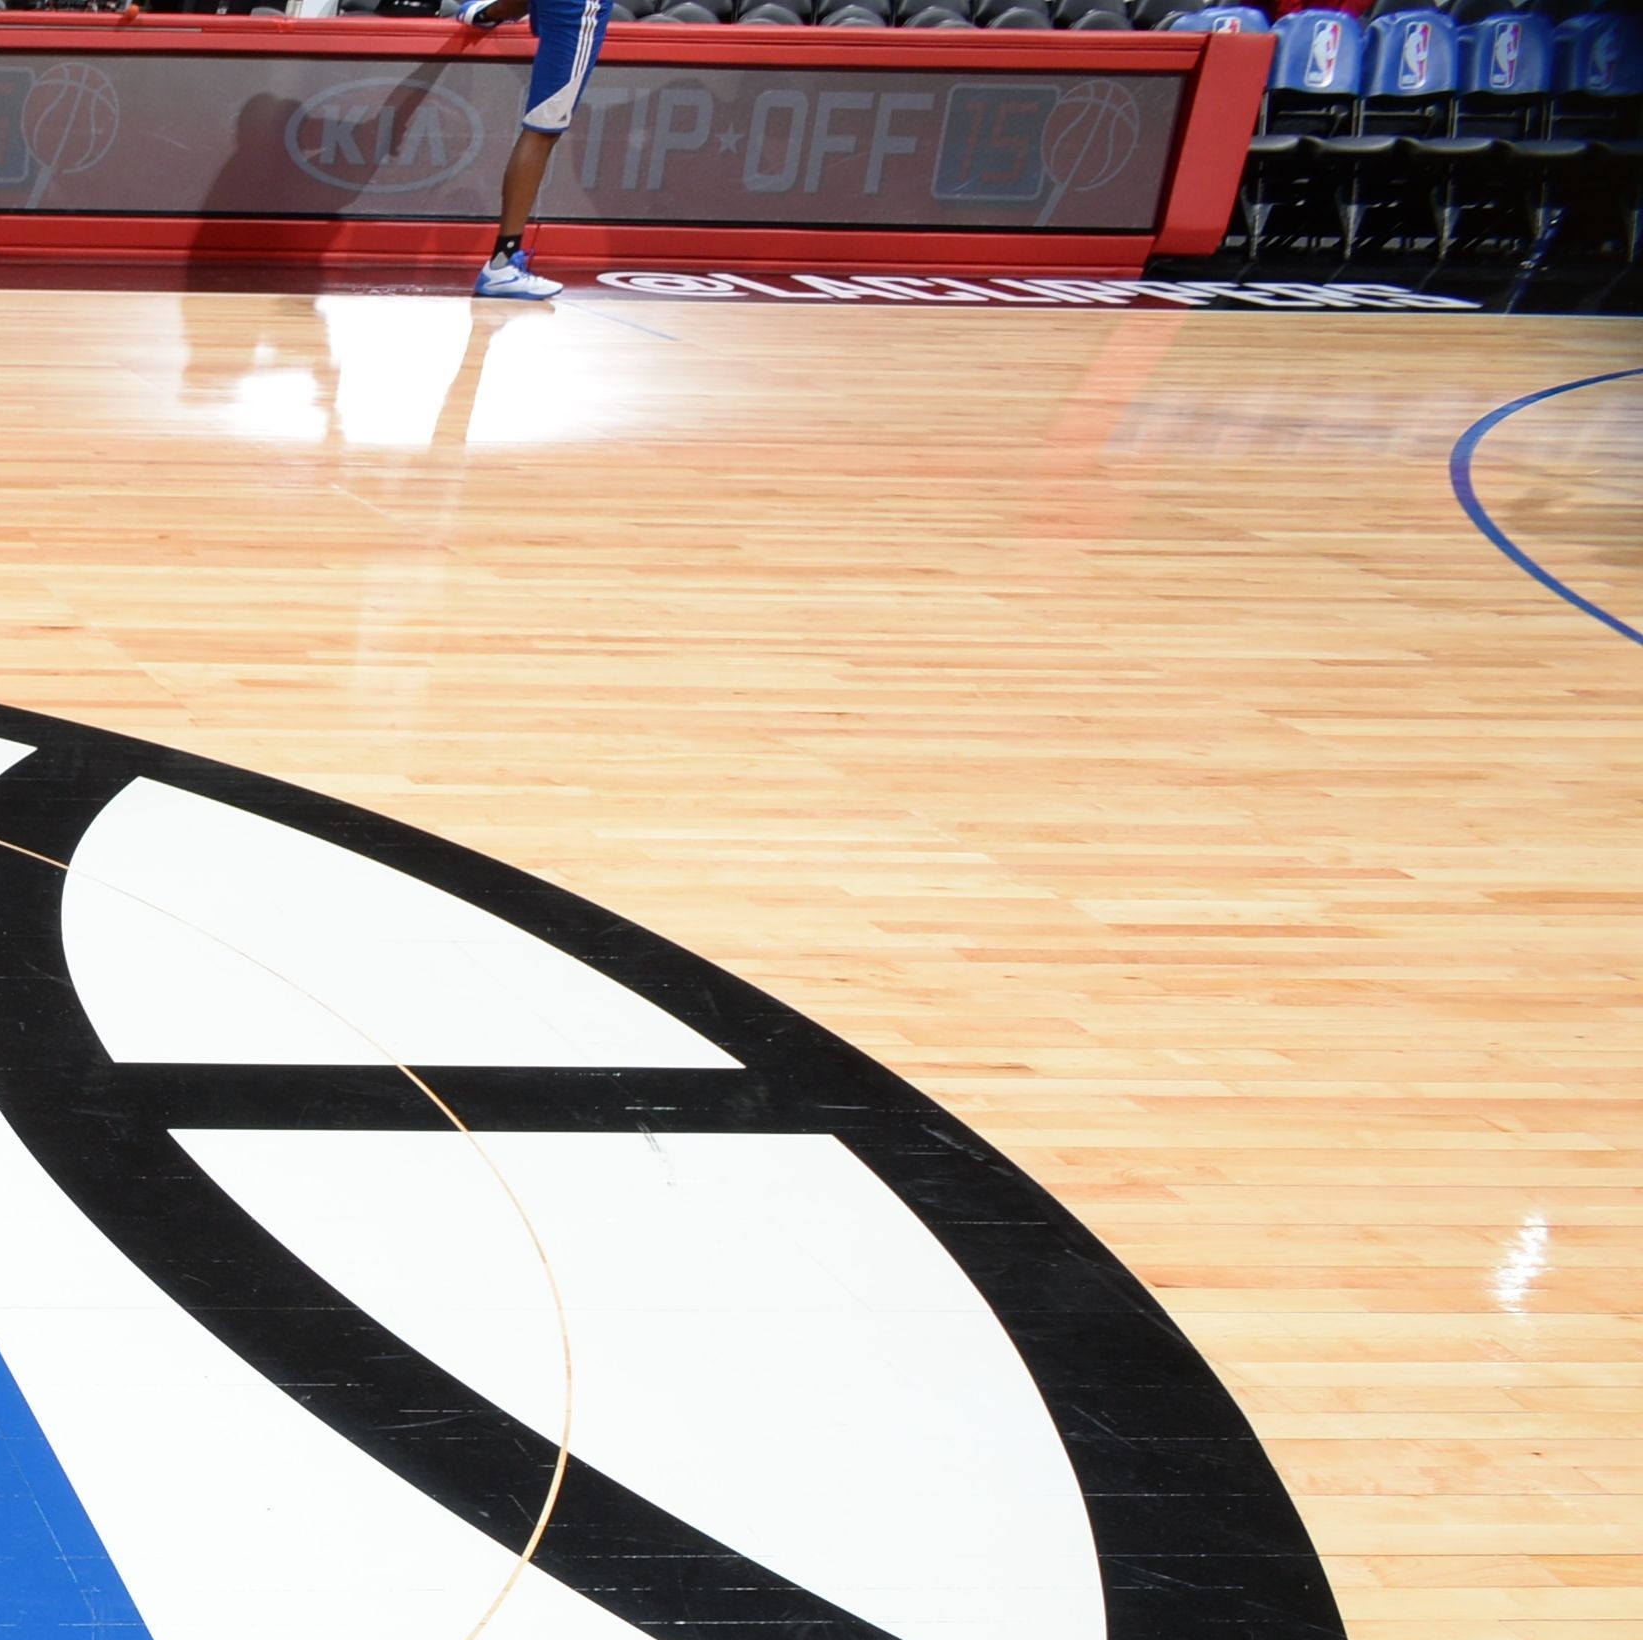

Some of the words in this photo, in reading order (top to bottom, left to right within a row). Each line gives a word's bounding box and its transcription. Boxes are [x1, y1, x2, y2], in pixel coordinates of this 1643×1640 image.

[317, 102, 450, 167] KIA
[741, 88, 936, 195] OFF
[957, 99, 1040, 185] 15
[594, 271, 1484, 310] @LACLIPPERS
